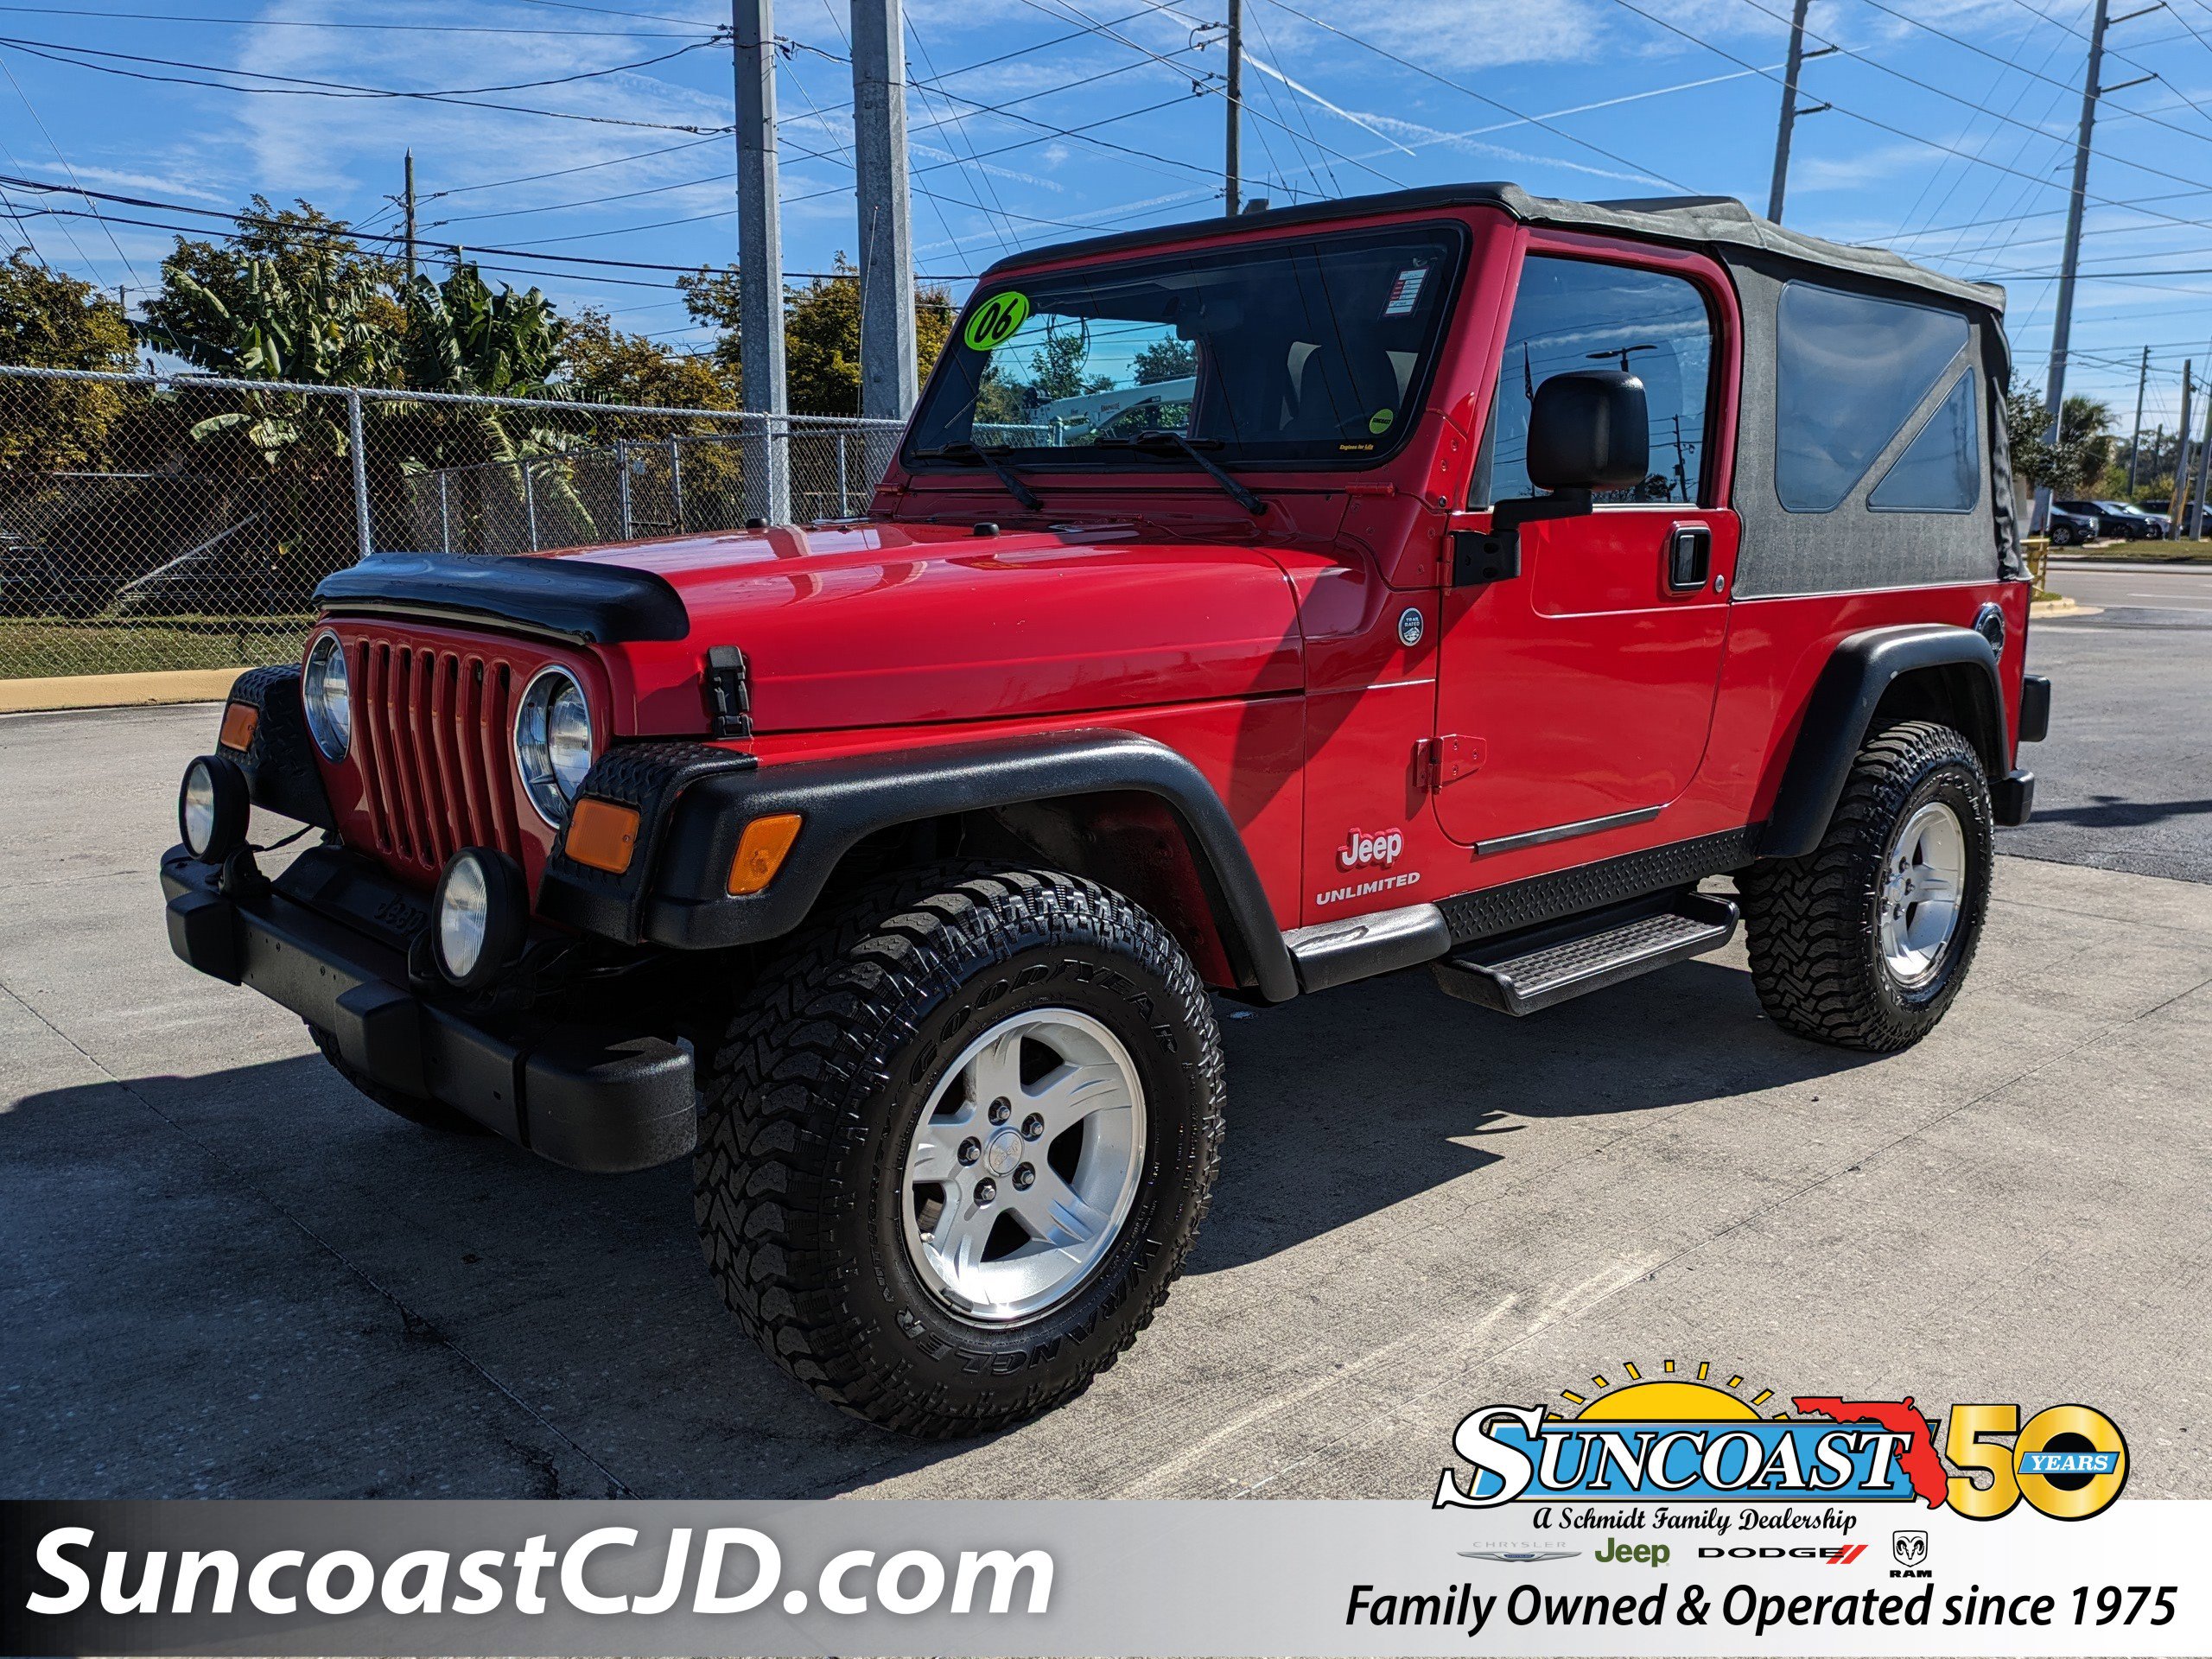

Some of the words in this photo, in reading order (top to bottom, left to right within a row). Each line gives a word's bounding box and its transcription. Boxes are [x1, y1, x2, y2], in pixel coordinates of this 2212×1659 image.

[974, 298, 1019, 343] 06
[1342, 833, 1402, 866] Jeep
[1316, 872, 1421, 906] UNLIMITED
[910, 958, 1179, 1085] GOODYEAR
[894, 1238, 1163, 1376] WRANGLER
